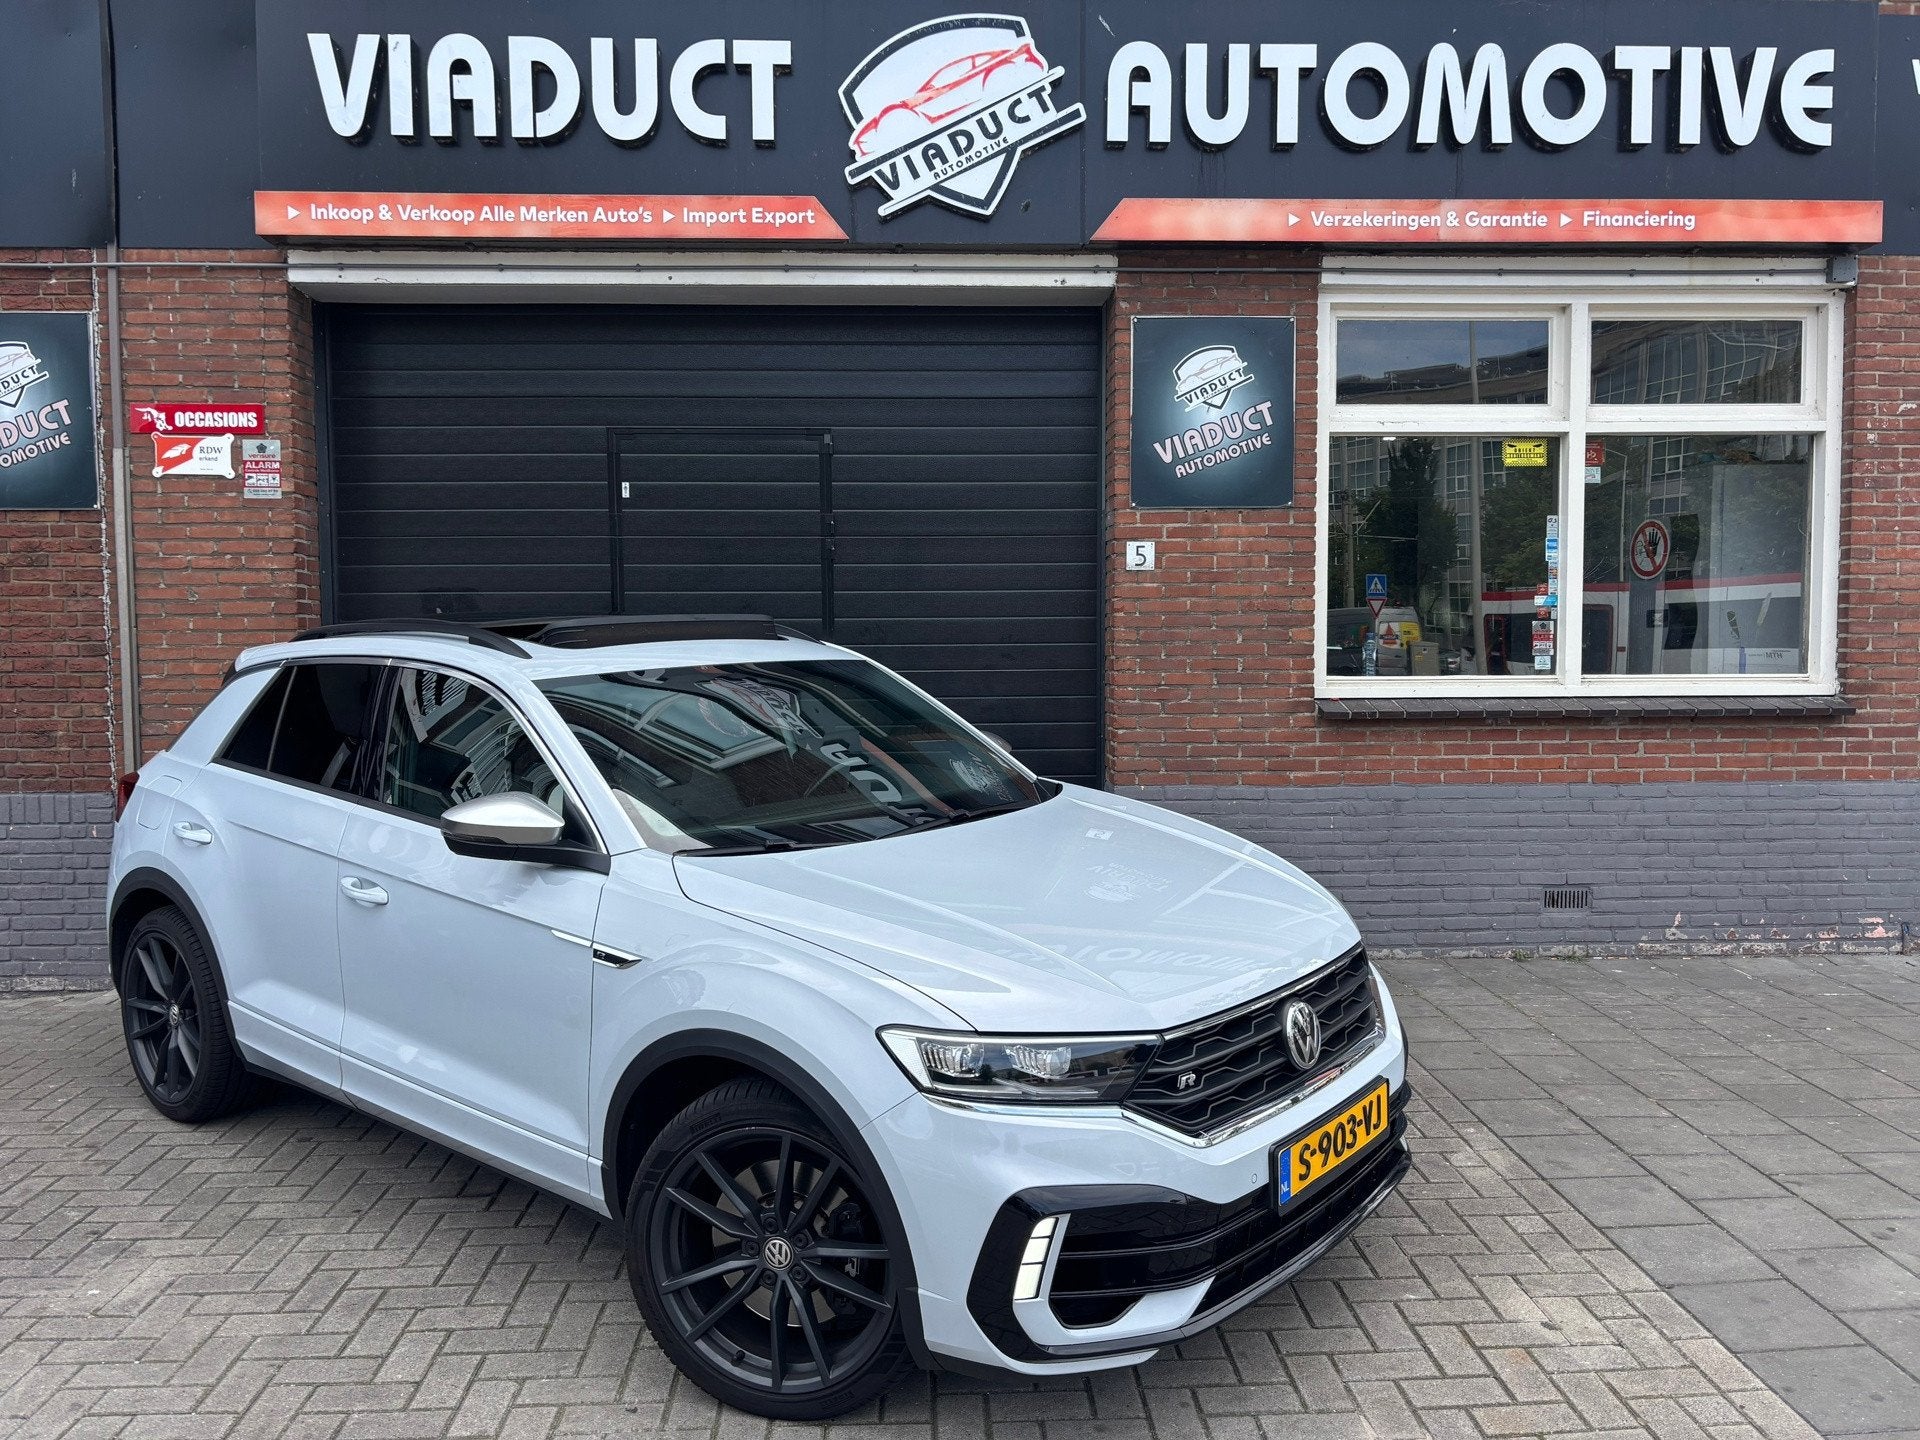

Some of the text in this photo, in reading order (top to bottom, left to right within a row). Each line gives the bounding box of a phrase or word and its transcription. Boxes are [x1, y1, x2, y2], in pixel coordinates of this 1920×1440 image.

[307, 32, 792, 141] VIADUCT
[1107, 41, 1835, 147] AUTOMOTIVE
[874, 85, 1050, 191] VIADUCT
[933, 136, 1009, 180] AUTOMOTIVE
[311, 203, 815, 227] Inkoop & Verkoop Alle Merken Auto's Import Export
[1310, 210, 1696, 231] Verzekeringen & Garantie Financiering
[0, 365, 38, 393] DUCT
[1184, 368, 1244, 404] VIADUCT
[174, 411, 258, 428] OCCASIONS
[1152, 400, 1274, 464] VIADUCT
[199, 446, 223, 454] RDW
[245, 461, 280, 469] ALARM
[1175, 432, 1272, 478] AUTOMOTIVE
[1134, 545, 1147, 567] 5
[1298, 1093, 1382, 1182] S-903-VJ
[1281, 1180, 1290, 1195] NL
